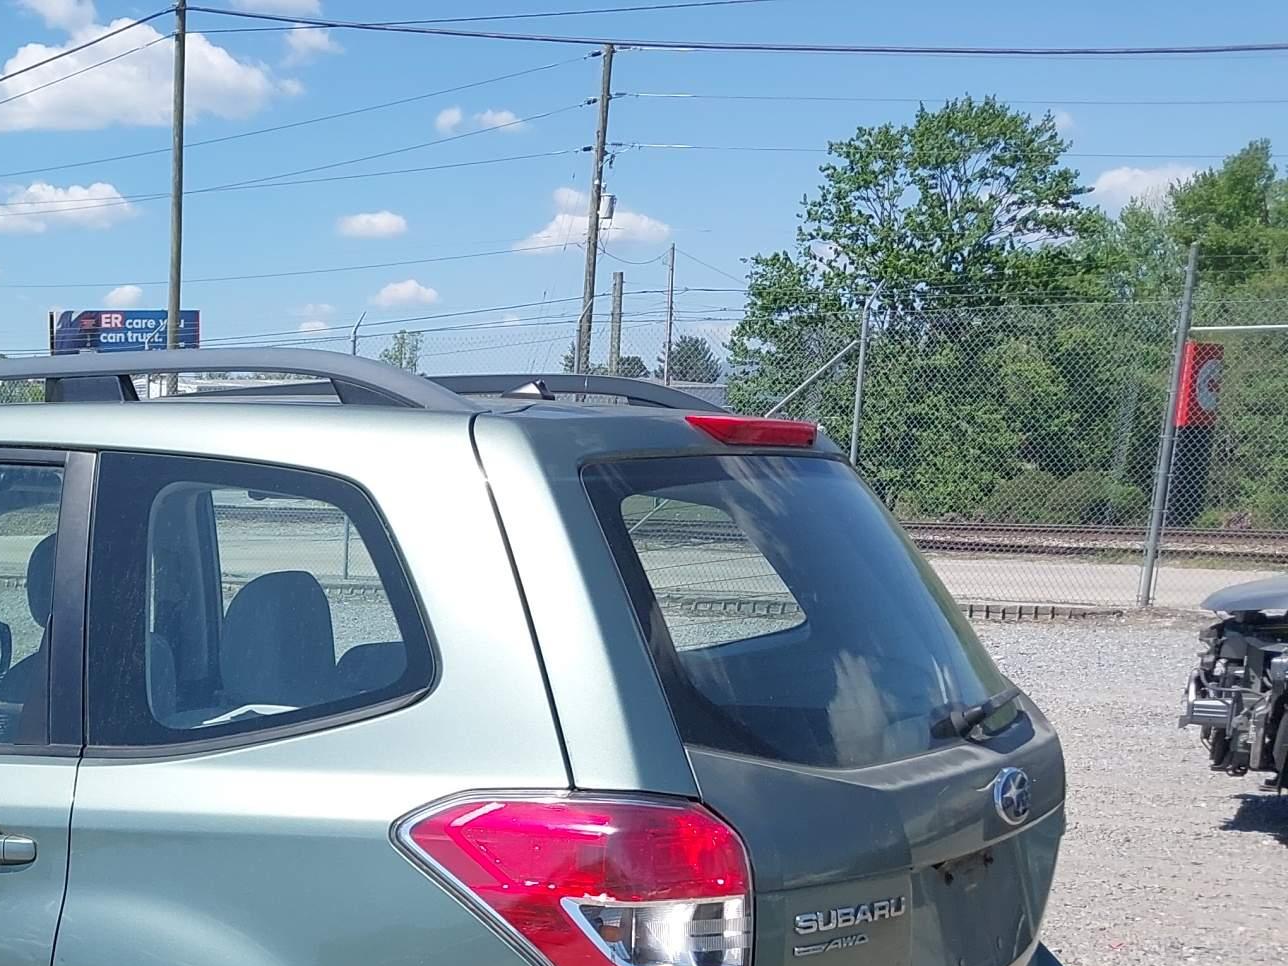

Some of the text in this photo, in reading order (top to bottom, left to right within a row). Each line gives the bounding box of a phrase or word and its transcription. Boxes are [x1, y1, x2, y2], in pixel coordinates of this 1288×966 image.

[101, 314, 185, 332] ER care yu
[100, 332, 125, 343] can
[795, 897, 905, 935] SUBARU
[824, 934, 869, 952] AWD
